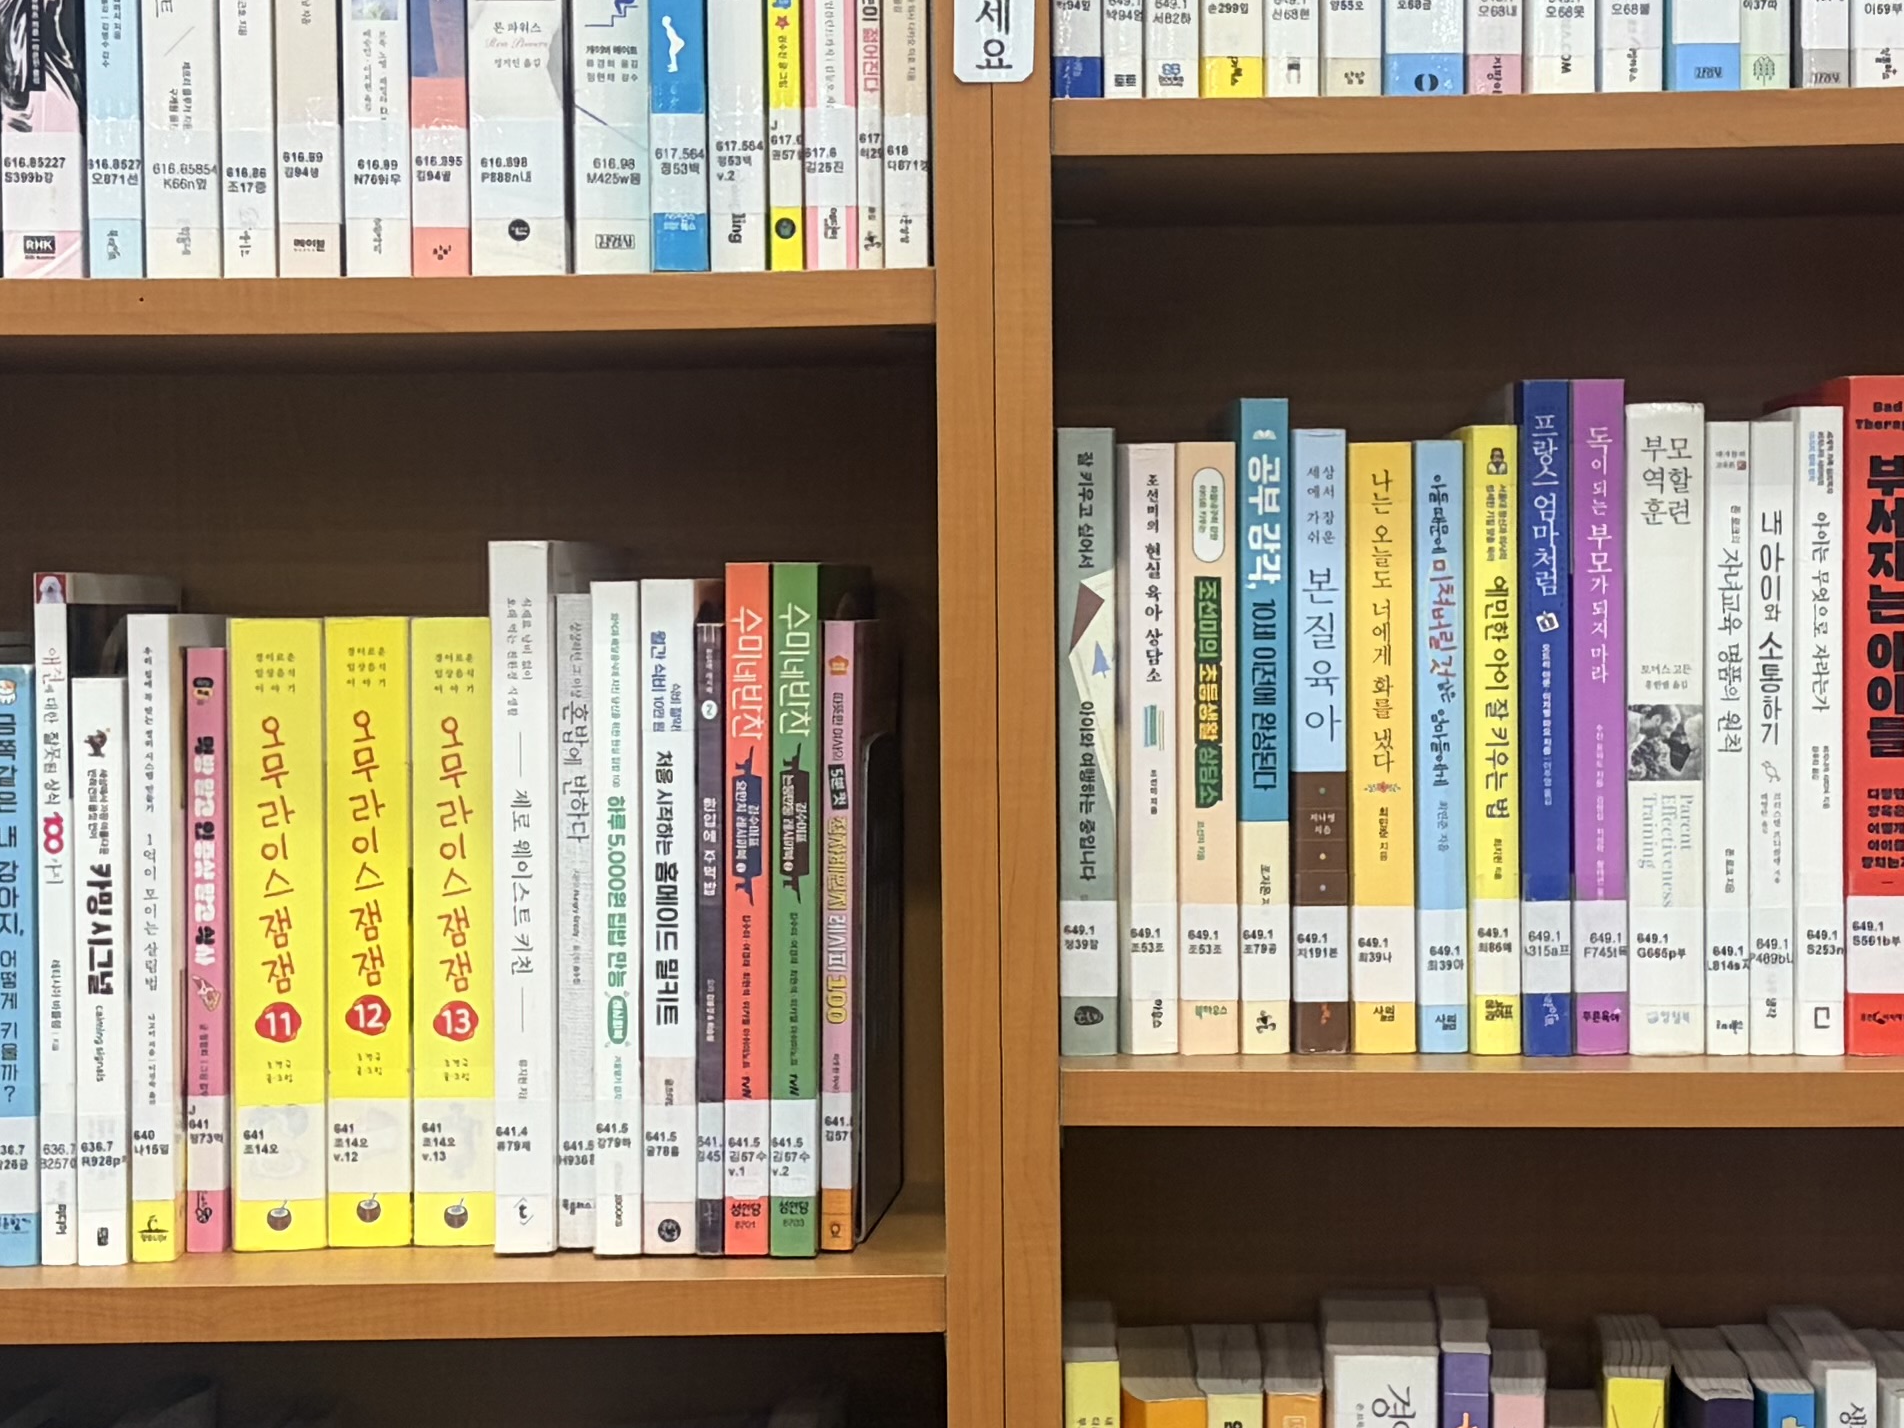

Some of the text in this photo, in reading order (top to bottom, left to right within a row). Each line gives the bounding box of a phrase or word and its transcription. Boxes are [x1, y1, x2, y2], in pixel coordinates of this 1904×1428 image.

[4, 157, 65, 168] 616.85227
[1873, 401, 1904, 414] Bad
[258, 716, 295, 1036] 오무라이스 잼잼 11
[354, 1003, 385, 1029] 12
[442, 1009, 470, 1034] 13
[334, 1124, 354, 1133] 641
[421, 1124, 442, 1133] 641
[333, 1152, 358, 1162] v.12
[422, 1152, 447, 1162] v.13
